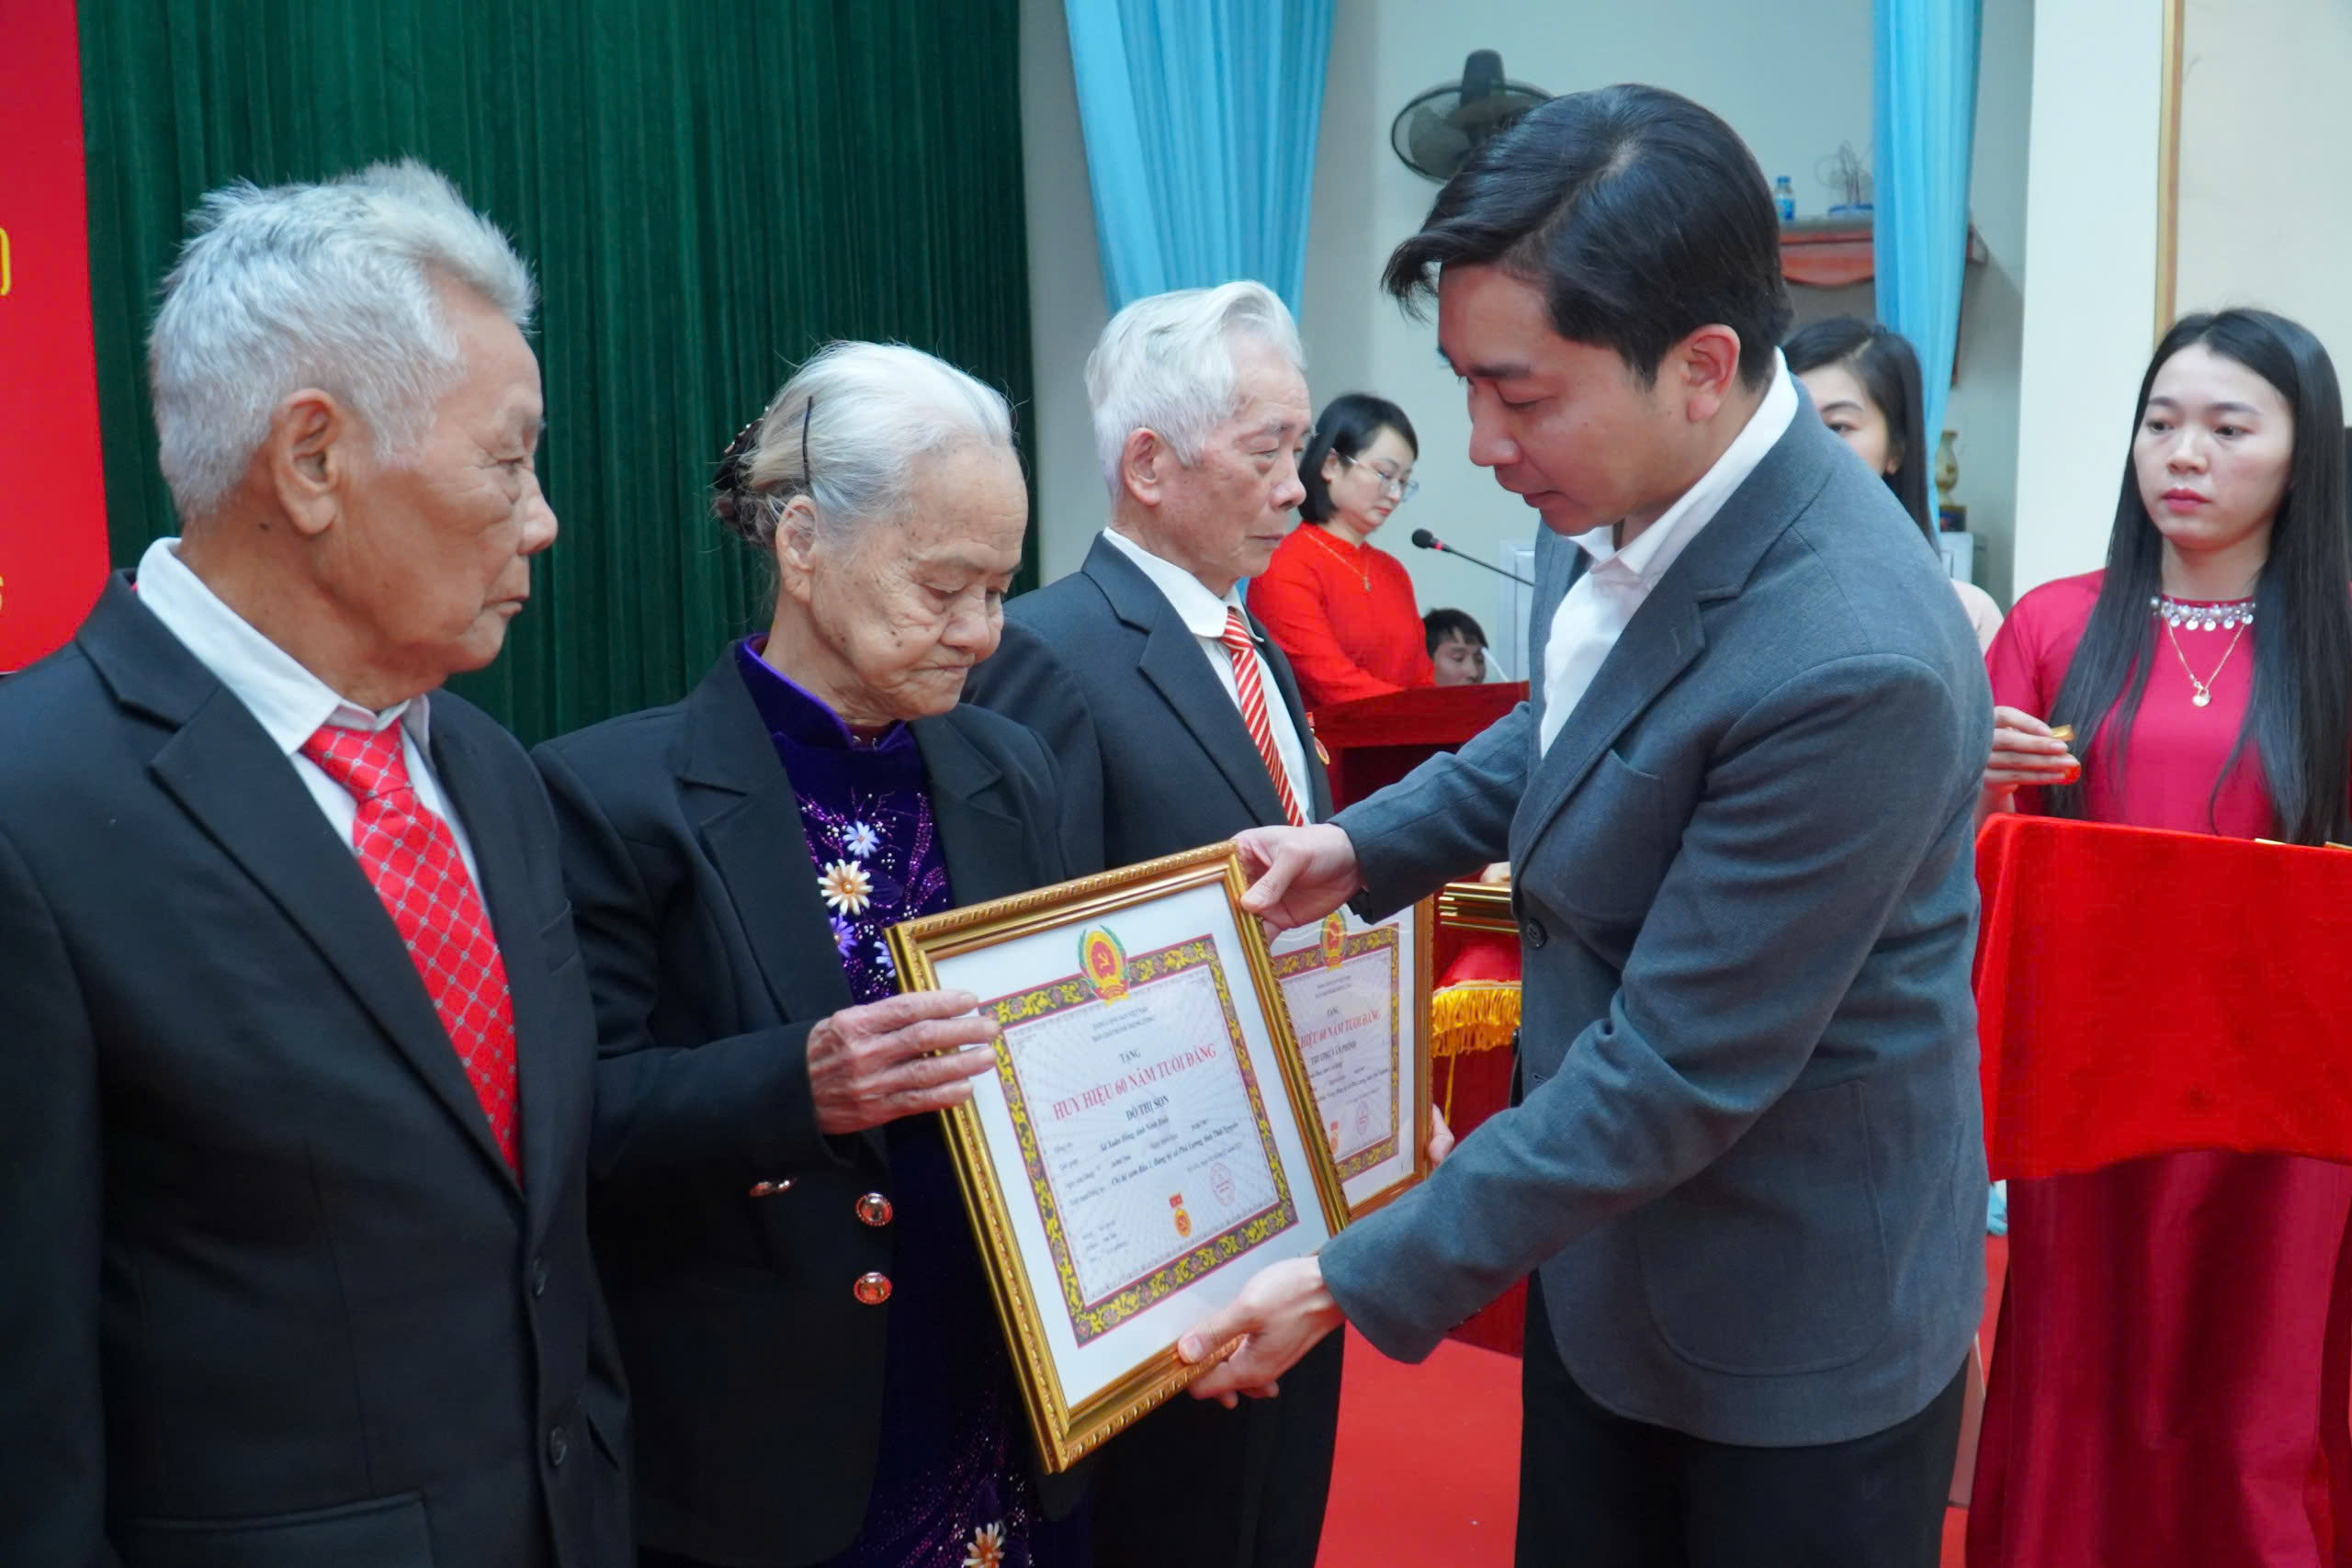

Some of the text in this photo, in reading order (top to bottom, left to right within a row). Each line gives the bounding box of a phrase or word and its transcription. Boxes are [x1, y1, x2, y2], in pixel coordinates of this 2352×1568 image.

[1052, 1043, 1216, 1121] HUY HIỆU 60 NĂM TUỔI ĐẢNG
